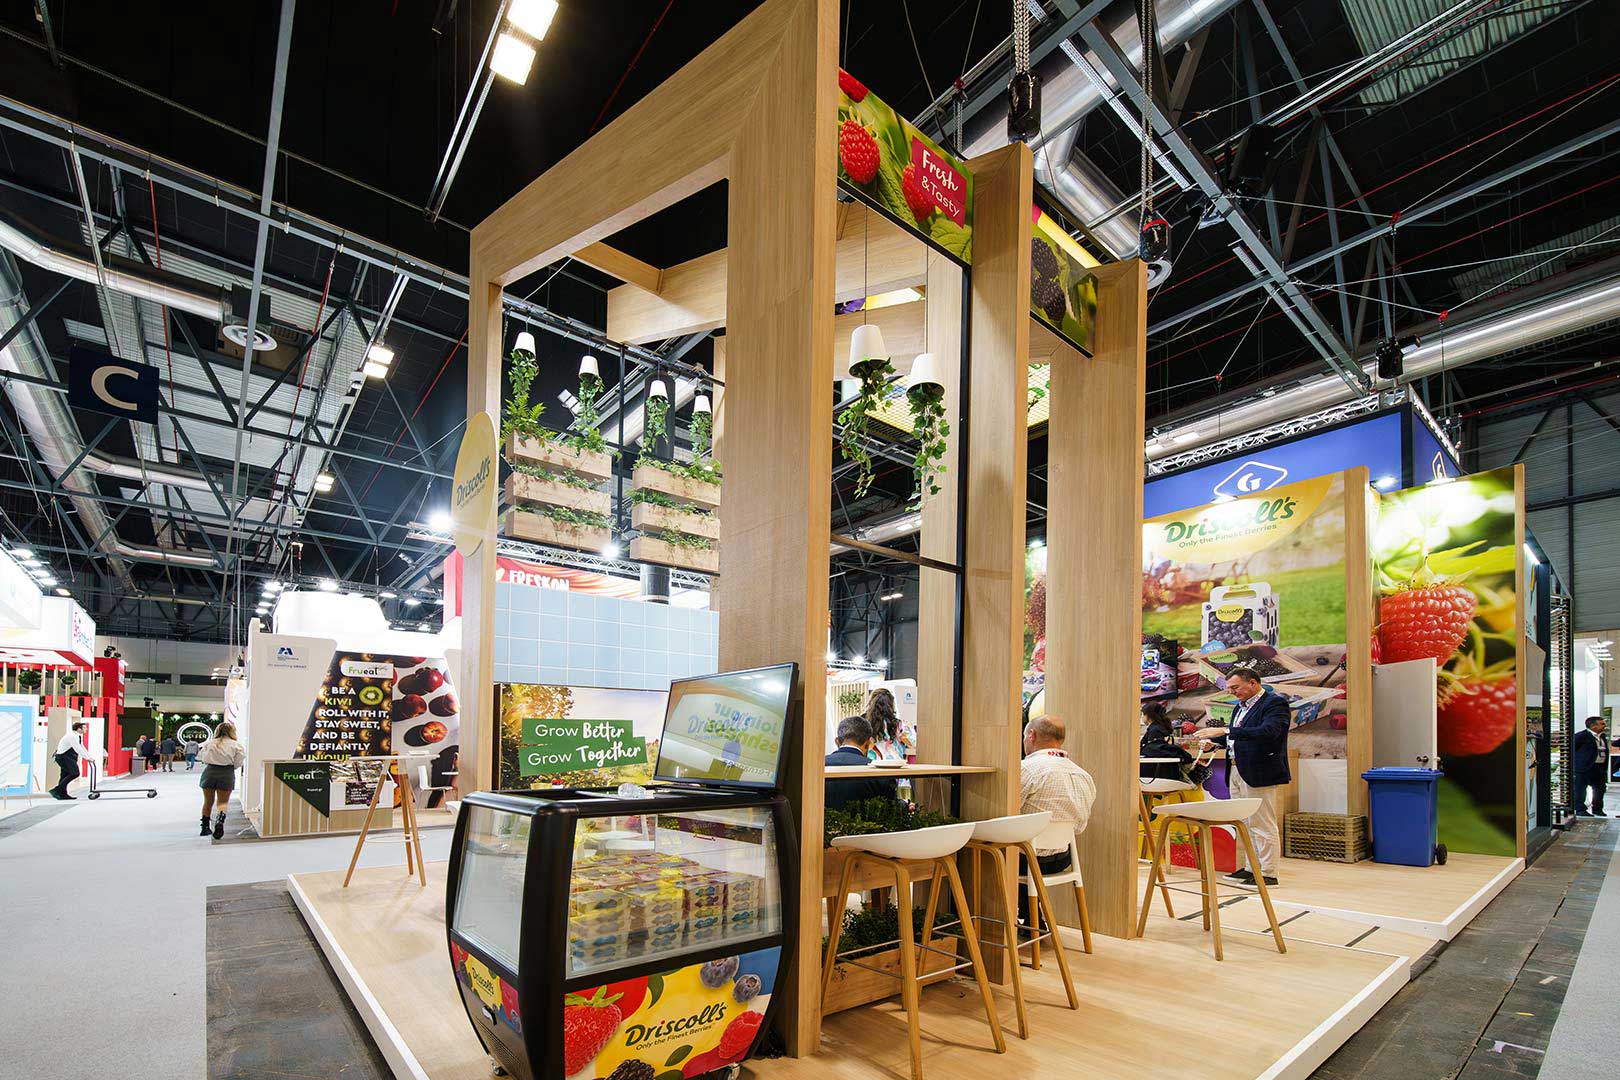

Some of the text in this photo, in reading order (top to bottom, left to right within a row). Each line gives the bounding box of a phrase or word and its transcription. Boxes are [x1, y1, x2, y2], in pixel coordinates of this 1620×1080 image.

[922, 149, 958, 191] Fresh
[91, 365, 139, 411] C
[1164, 496, 1297, 544] Drisll's
[1178, 538, 1200, 549] Only
[509, 569, 569, 591] FRESKON
[348, 666, 379, 676] Frueat
[331, 686, 357, 695] BE A
[324, 697, 352, 706] KIWI
[318, 708, 389, 719] ROLL WITH IT,
[315, 720, 380, 730] STAY SWEET,
[312, 731, 355, 740] AND BE
[535, 721, 625, 742] Grow Better
[309, 742, 370, 751] DEFIANTLY
[527, 741, 641, 767] Grow Together
[283, 769, 315, 780] Frueat
[625, 1002, 727, 1046] Driscoll's
[636, 1025, 712, 1050] Only the Finest Berries
